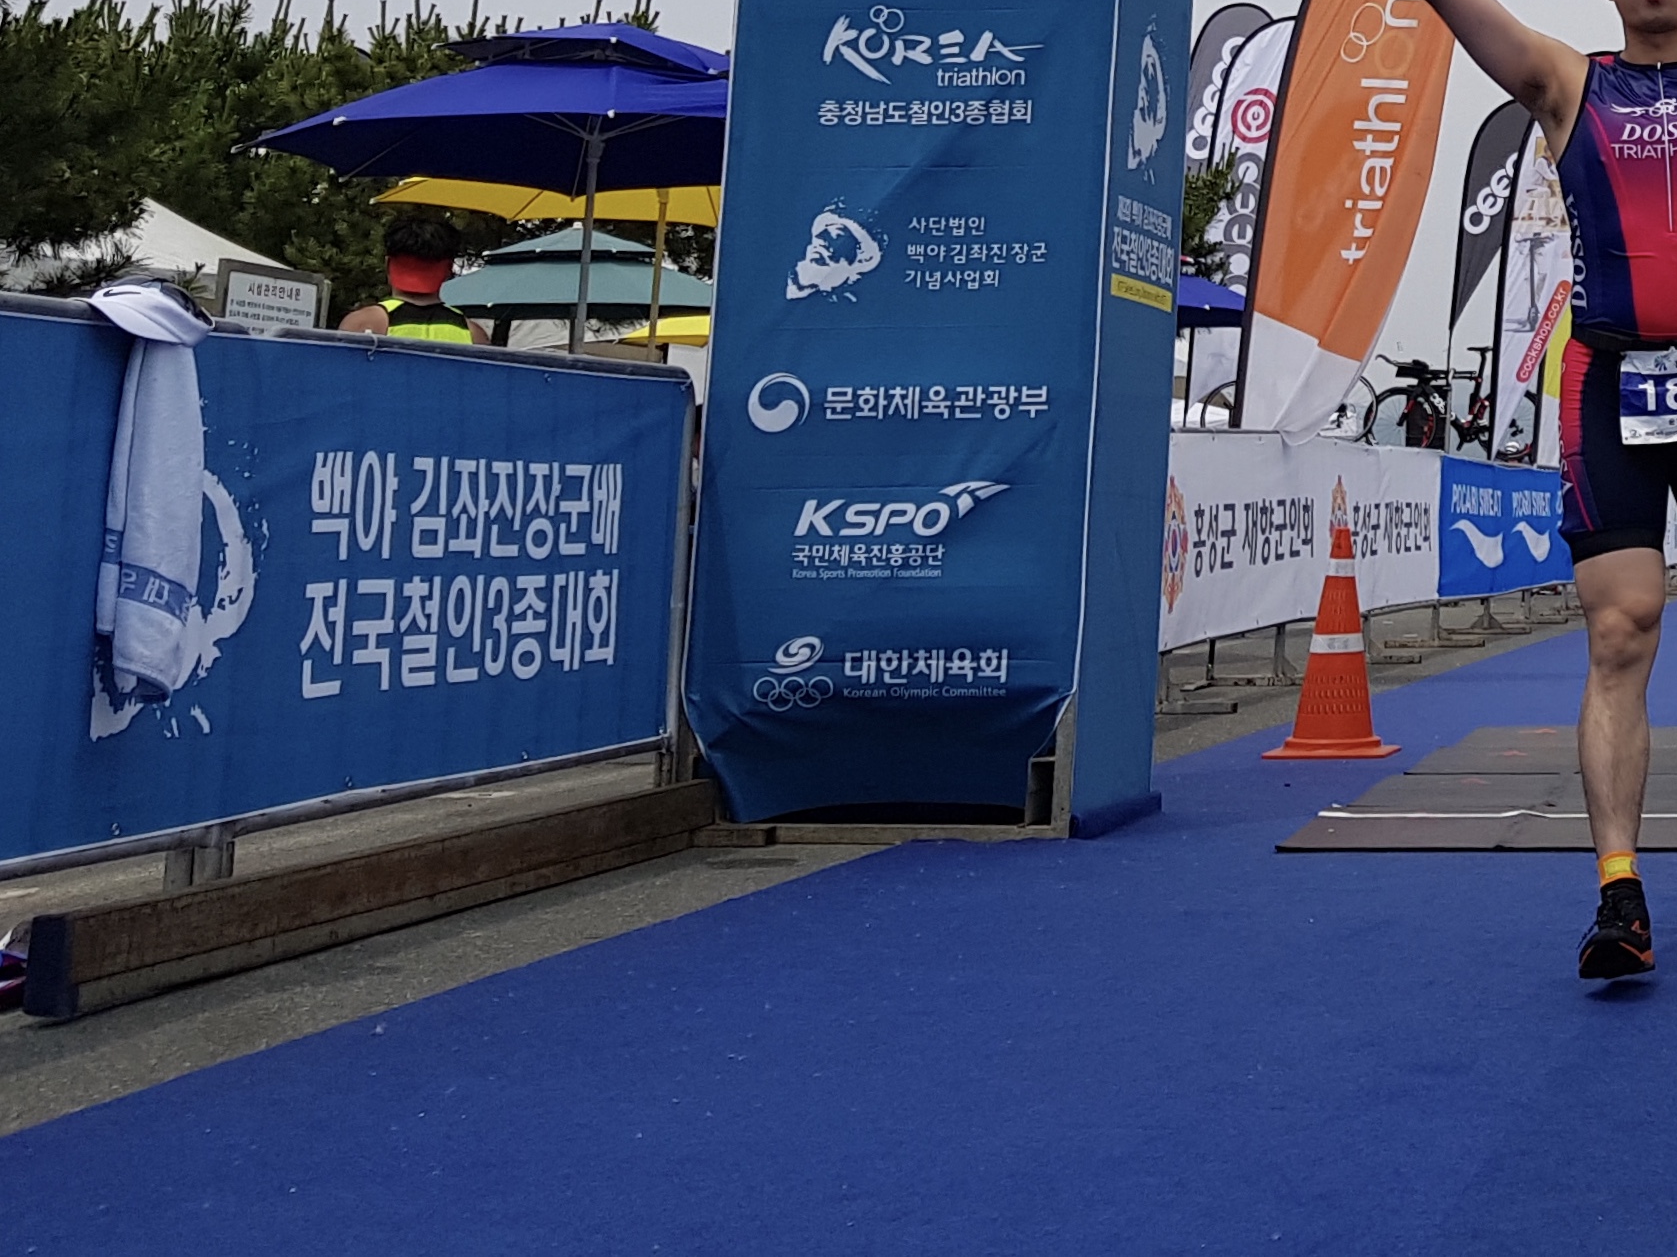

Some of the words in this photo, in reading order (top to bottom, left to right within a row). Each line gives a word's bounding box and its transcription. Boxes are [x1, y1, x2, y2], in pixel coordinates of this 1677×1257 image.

[936, 67, 1026, 87] triathlon
[817, 99, 1033, 126] 충청남도철인3종협회
[908, 216, 987, 237] 사단법인
[904, 269, 1000, 291] 기념사업회
[1519, 285, 1568, 379] cockshop.co.kr
[823, 385, 1049, 420] 문화체육관광부
[310, 449, 399, 561] 백야
[410, 456, 624, 559] 김좌진장군배
[793, 498, 951, 537] KSPO
[1450, 483, 1479, 515] POCARI
[1479, 487, 1502, 518] SWEAT
[1192, 502, 1238, 578] 홍성군
[1242, 496, 1315, 566] 재향군인회
[1351, 501, 1382, 560] 홍성군
[1383, 499, 1432, 555] 재향군인회
[791, 543, 945, 567] 국민체육진흥공단
[792, 568, 817, 578] Korea
[819, 568, 845, 581] Sports
[847, 568, 891, 578] Promotion
[893, 568, 942, 578] Foundation
[300, 568, 621, 699] 전국철인3종대회
[843, 648, 1009, 684] 대한체육회
[843, 687, 887, 697] Korean
[890, 686, 939, 699] Olympic
[941, 686, 1007, 697] Committee
